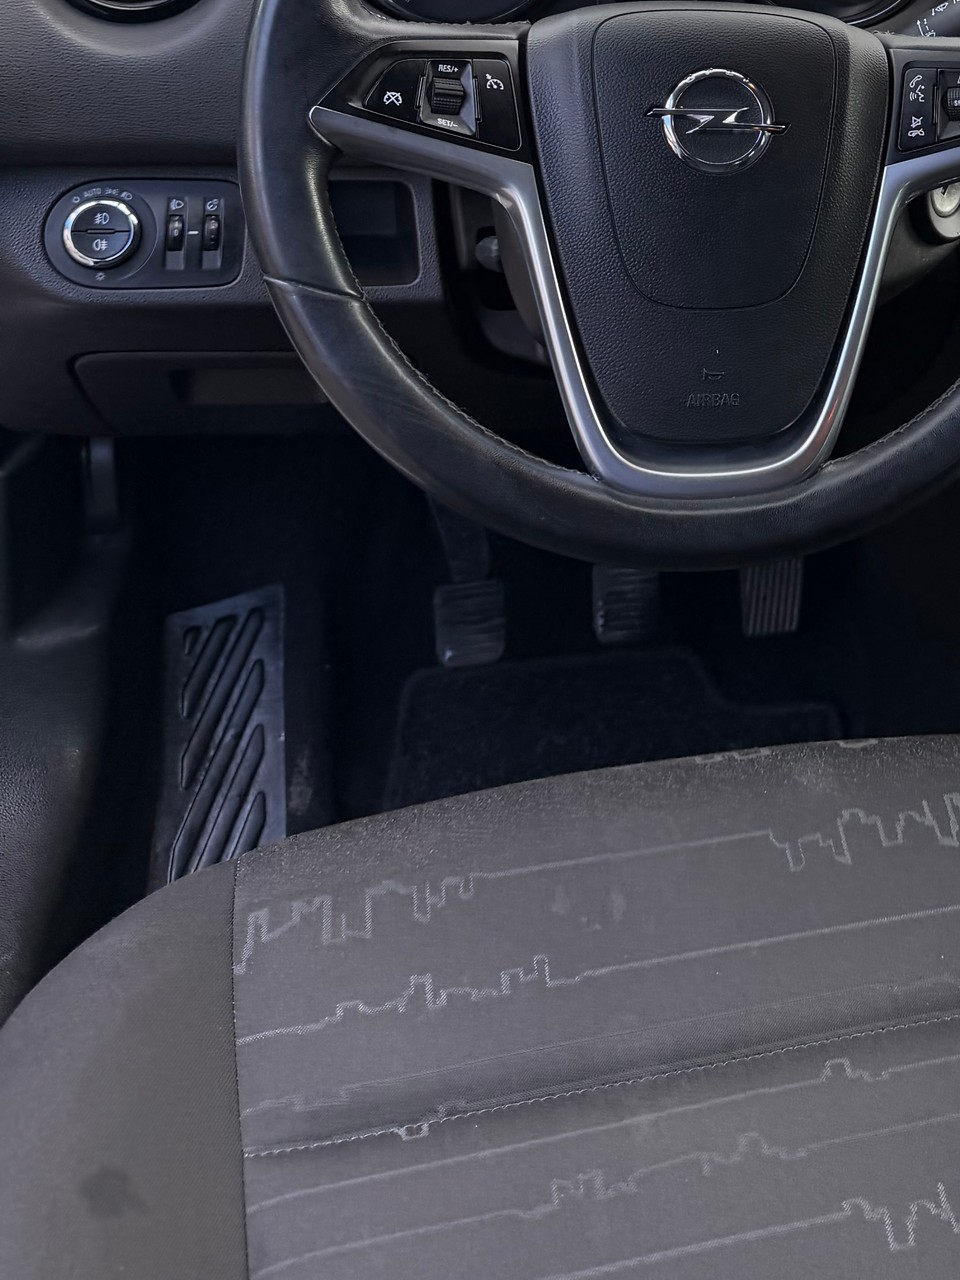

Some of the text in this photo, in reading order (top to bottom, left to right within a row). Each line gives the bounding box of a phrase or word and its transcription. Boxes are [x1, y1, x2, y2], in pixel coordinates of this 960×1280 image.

[438, 64, 459, 73] RES/+
[84, 187, 102, 199] AUTO
[686, 392, 740, 408] AIRBAG
